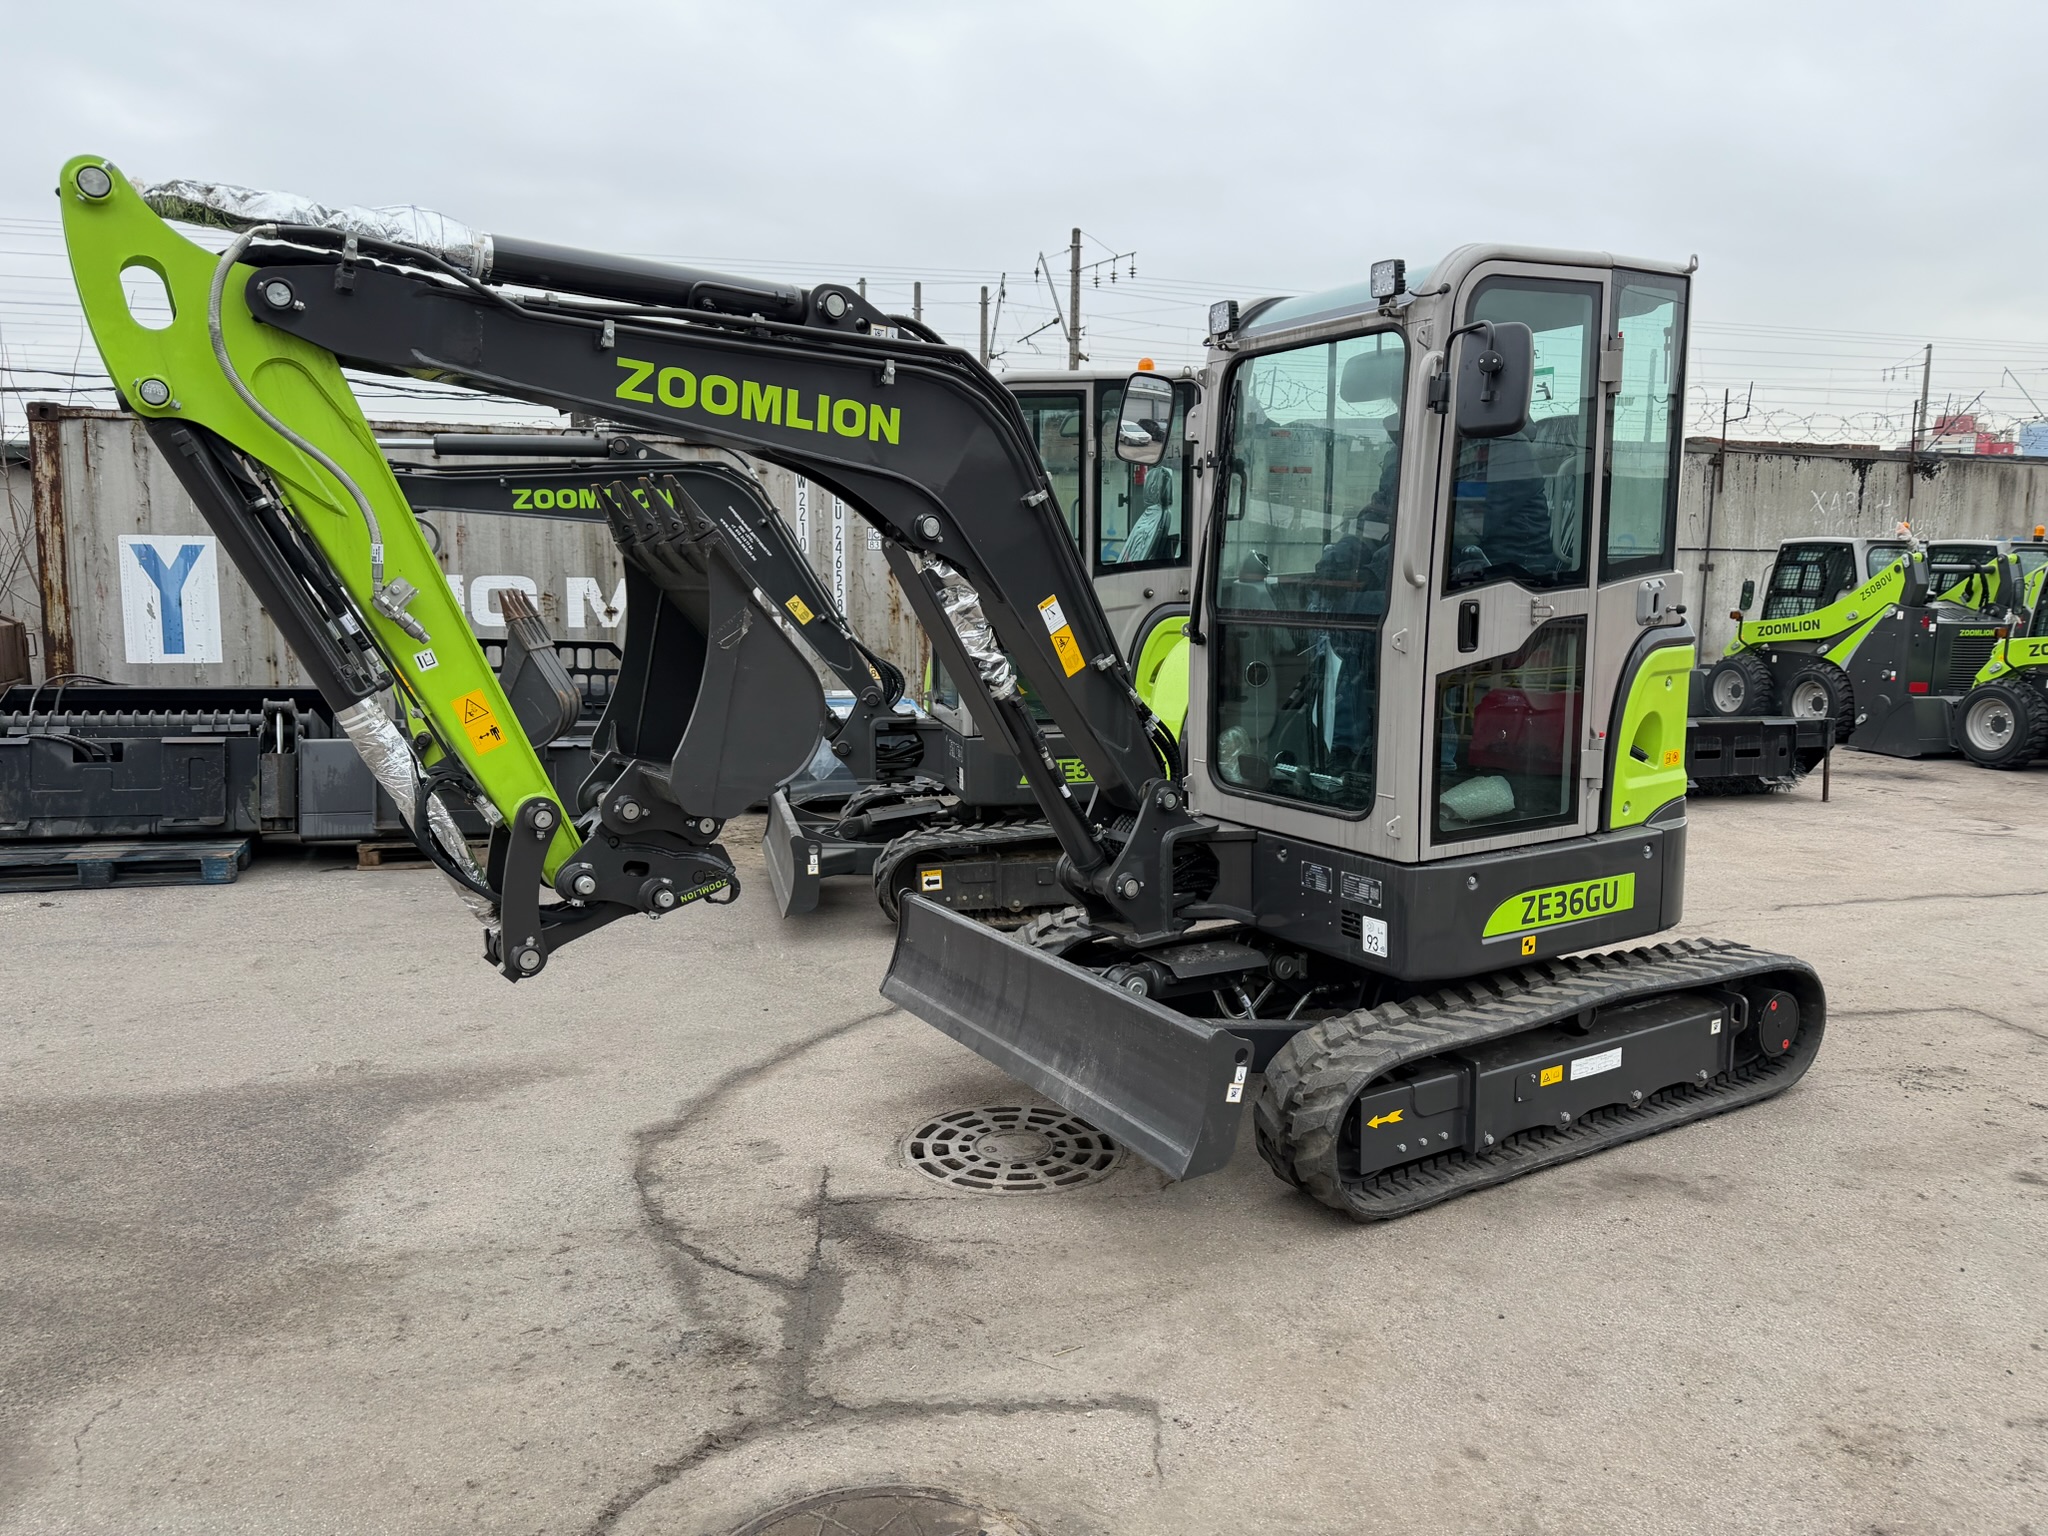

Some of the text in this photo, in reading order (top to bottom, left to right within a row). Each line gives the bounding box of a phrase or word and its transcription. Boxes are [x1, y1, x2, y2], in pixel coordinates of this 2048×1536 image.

[615, 356, 901, 445] ZOOMLION
[511, 488, 675, 510] ZOOMO
[128, 543, 206, 655] Y
[1757, 618, 1821, 637] ZOOMLION
[1959, 629, 1995, 637] ZOOMLION
[1057, 761, 1089, 780] E3
[679, 878, 729, 903] ZOOMLION
[1521, 880, 1619, 925] ZE36GU
[1366, 934, 1379, 952] 93
